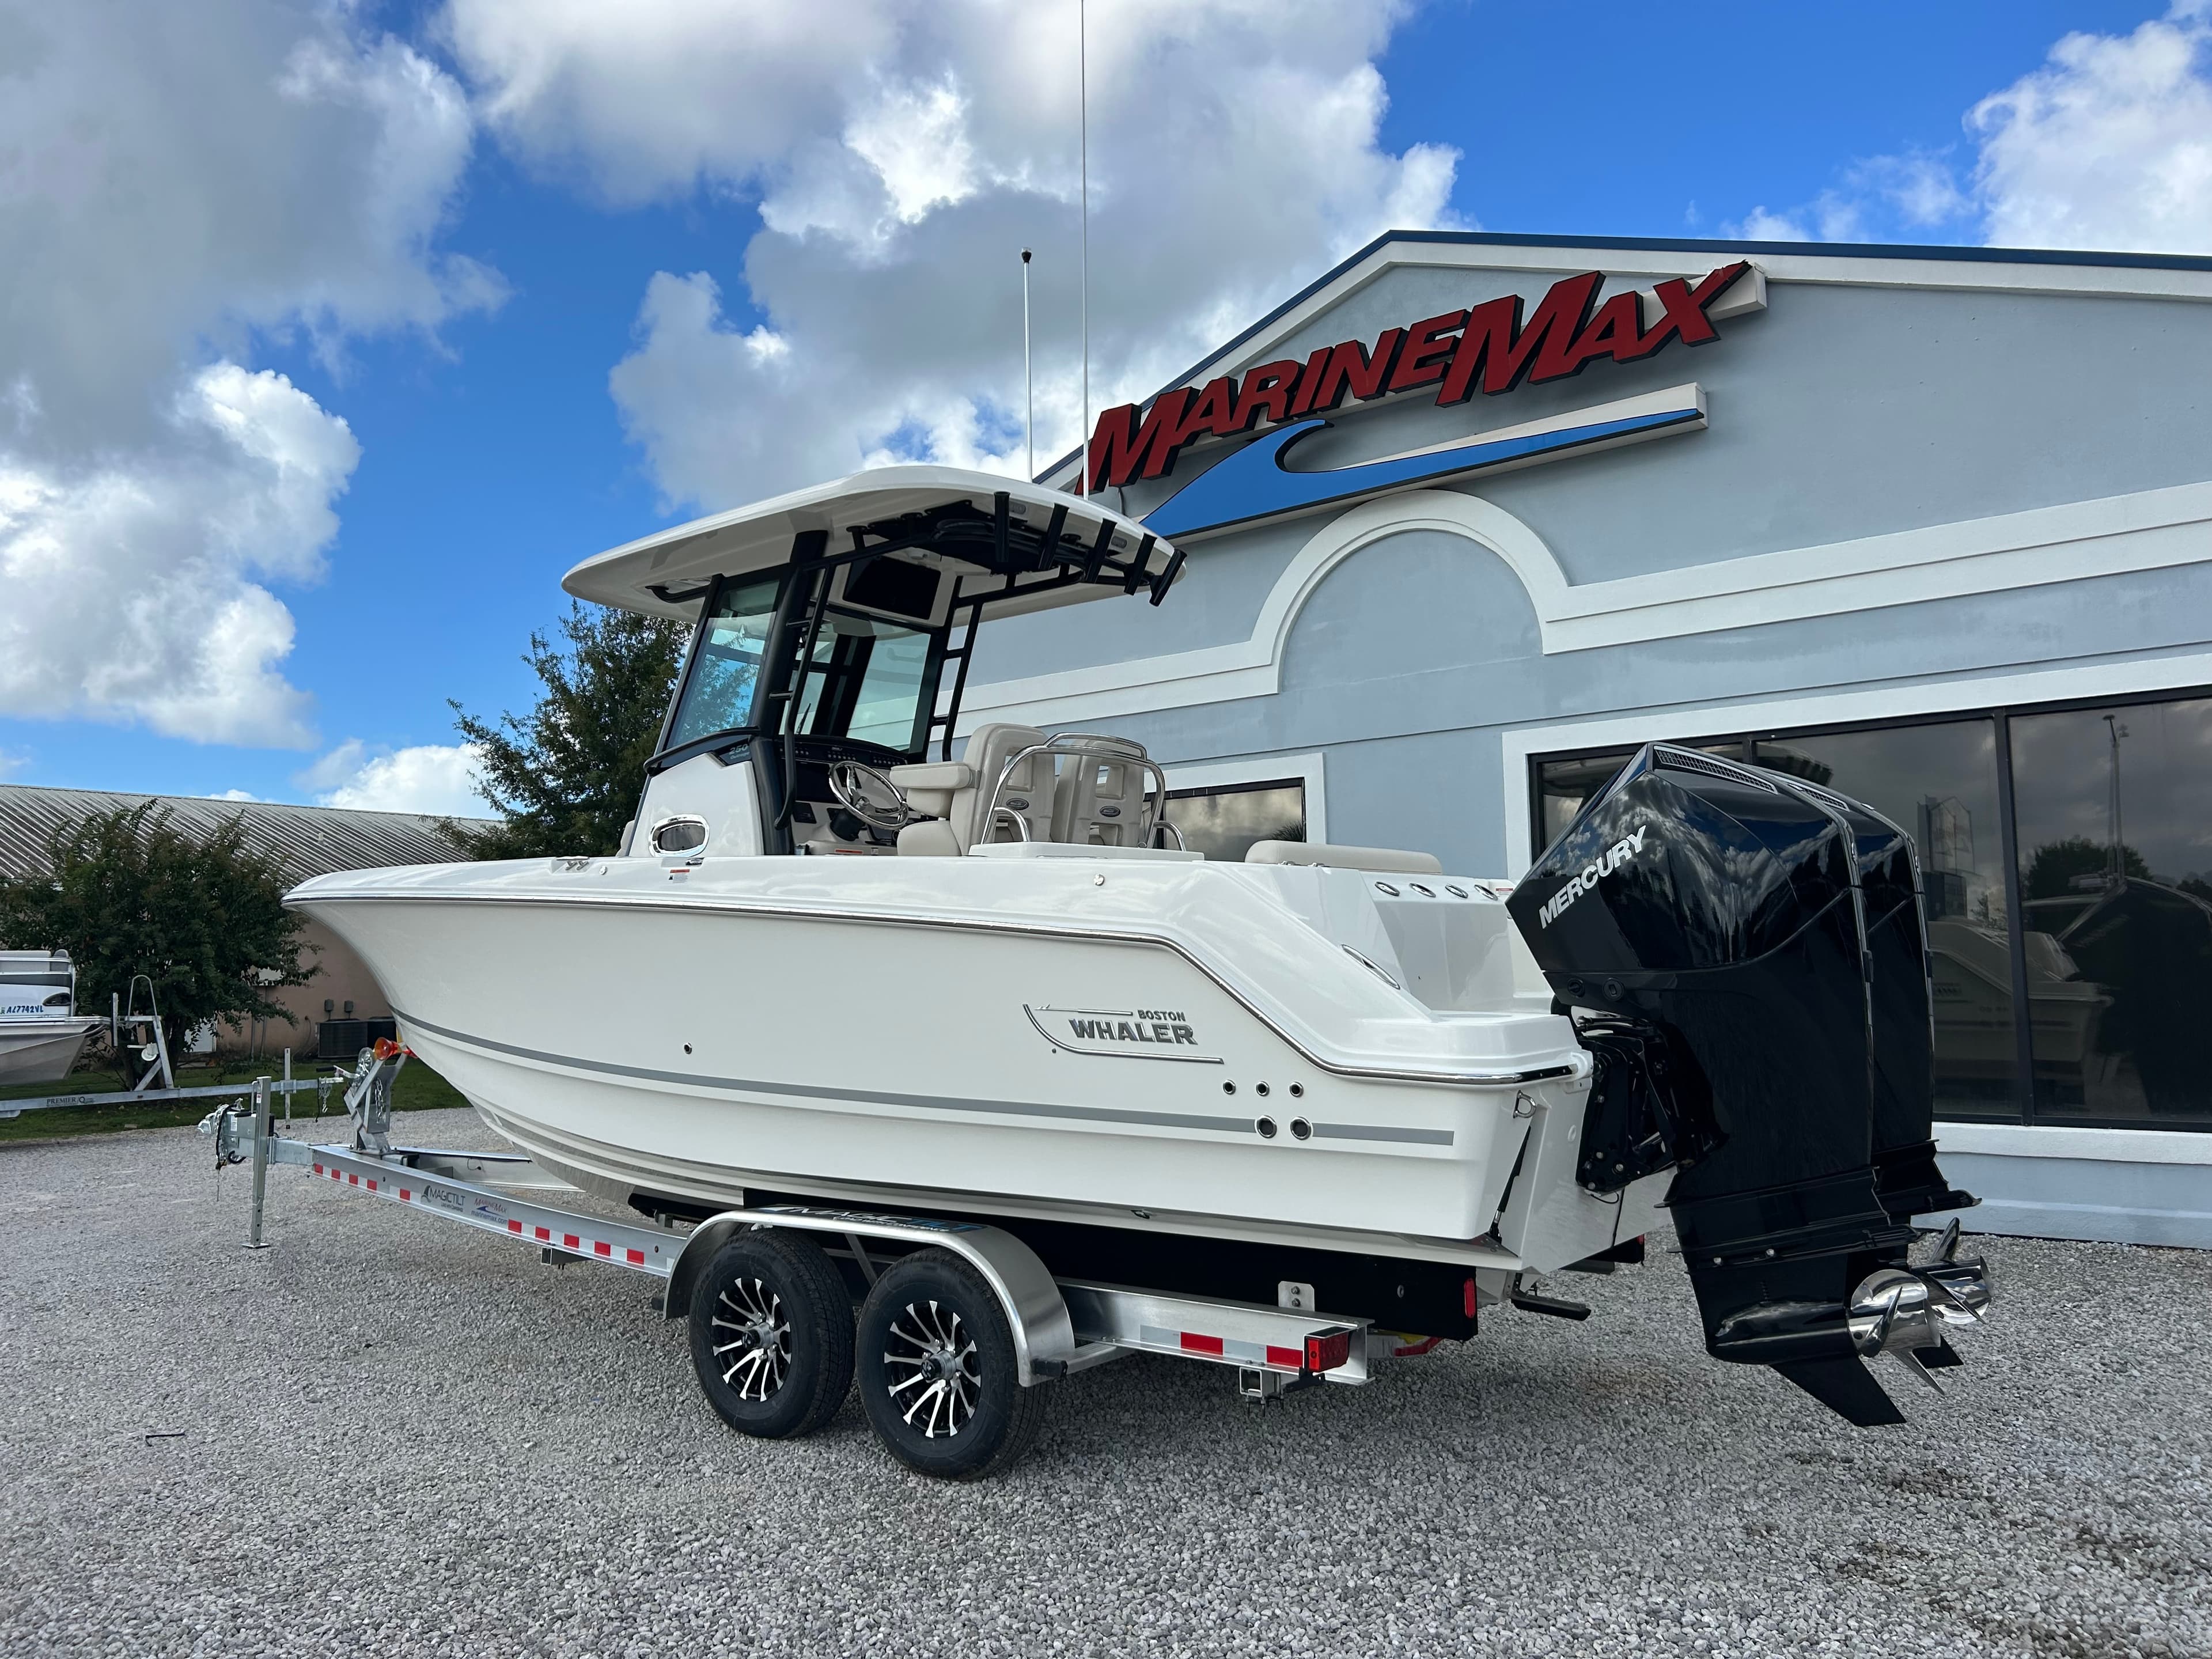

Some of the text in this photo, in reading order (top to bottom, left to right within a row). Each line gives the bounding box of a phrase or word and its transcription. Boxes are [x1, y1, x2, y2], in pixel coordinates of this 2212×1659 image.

[729, 744, 748, 755] 250
[1539, 825, 1646, 929] MERCURY
[6, 1005, 44, 1014] AL7742VL
[1137, 1009, 1186, 1022] BOSTON
[1069, 1018, 1199, 1045] WHALER
[430, 1187, 466, 1206] MAGICTILT
[471, 1210, 507, 1225] marinemax.com
[788, 1208, 983, 1232] MAGICTILT
